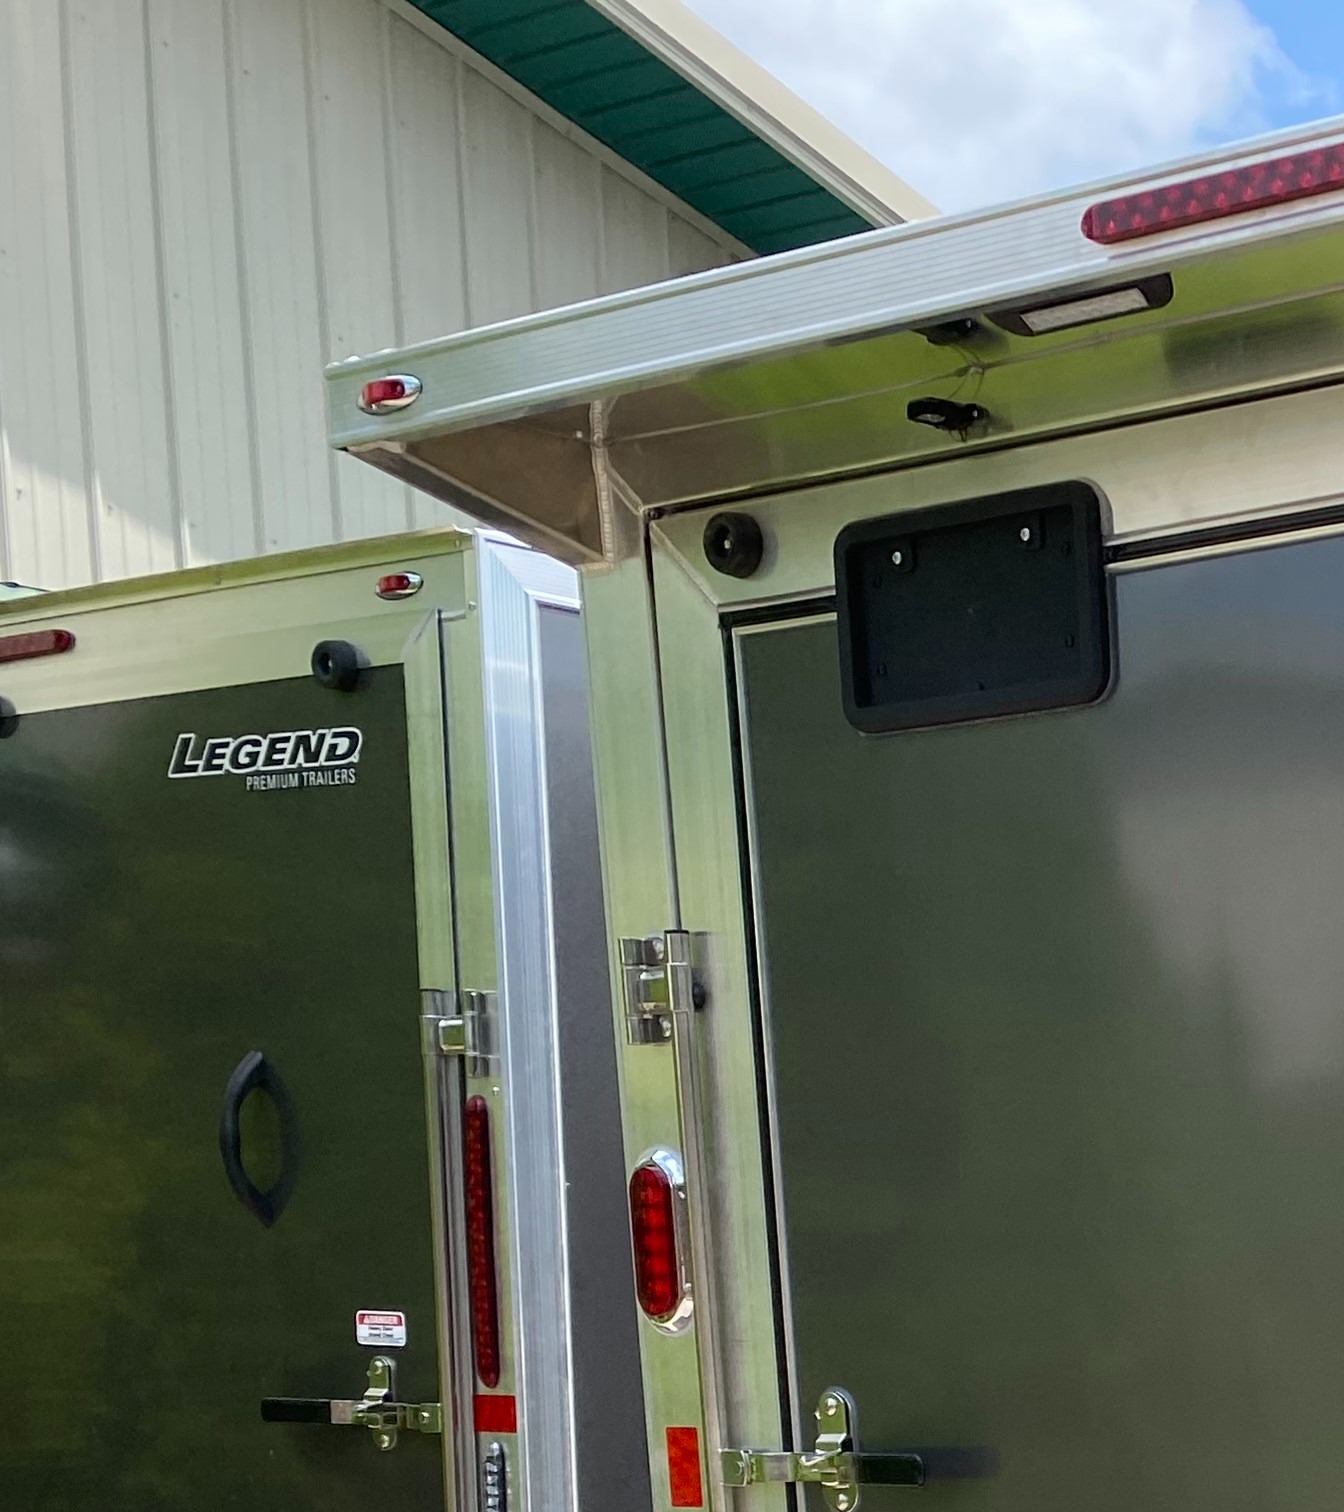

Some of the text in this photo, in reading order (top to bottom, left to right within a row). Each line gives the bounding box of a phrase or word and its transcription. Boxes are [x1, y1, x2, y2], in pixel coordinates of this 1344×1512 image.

[168, 727, 362, 778] LEGEND
[246, 768, 356, 791] PREMIUM TRAILERS
